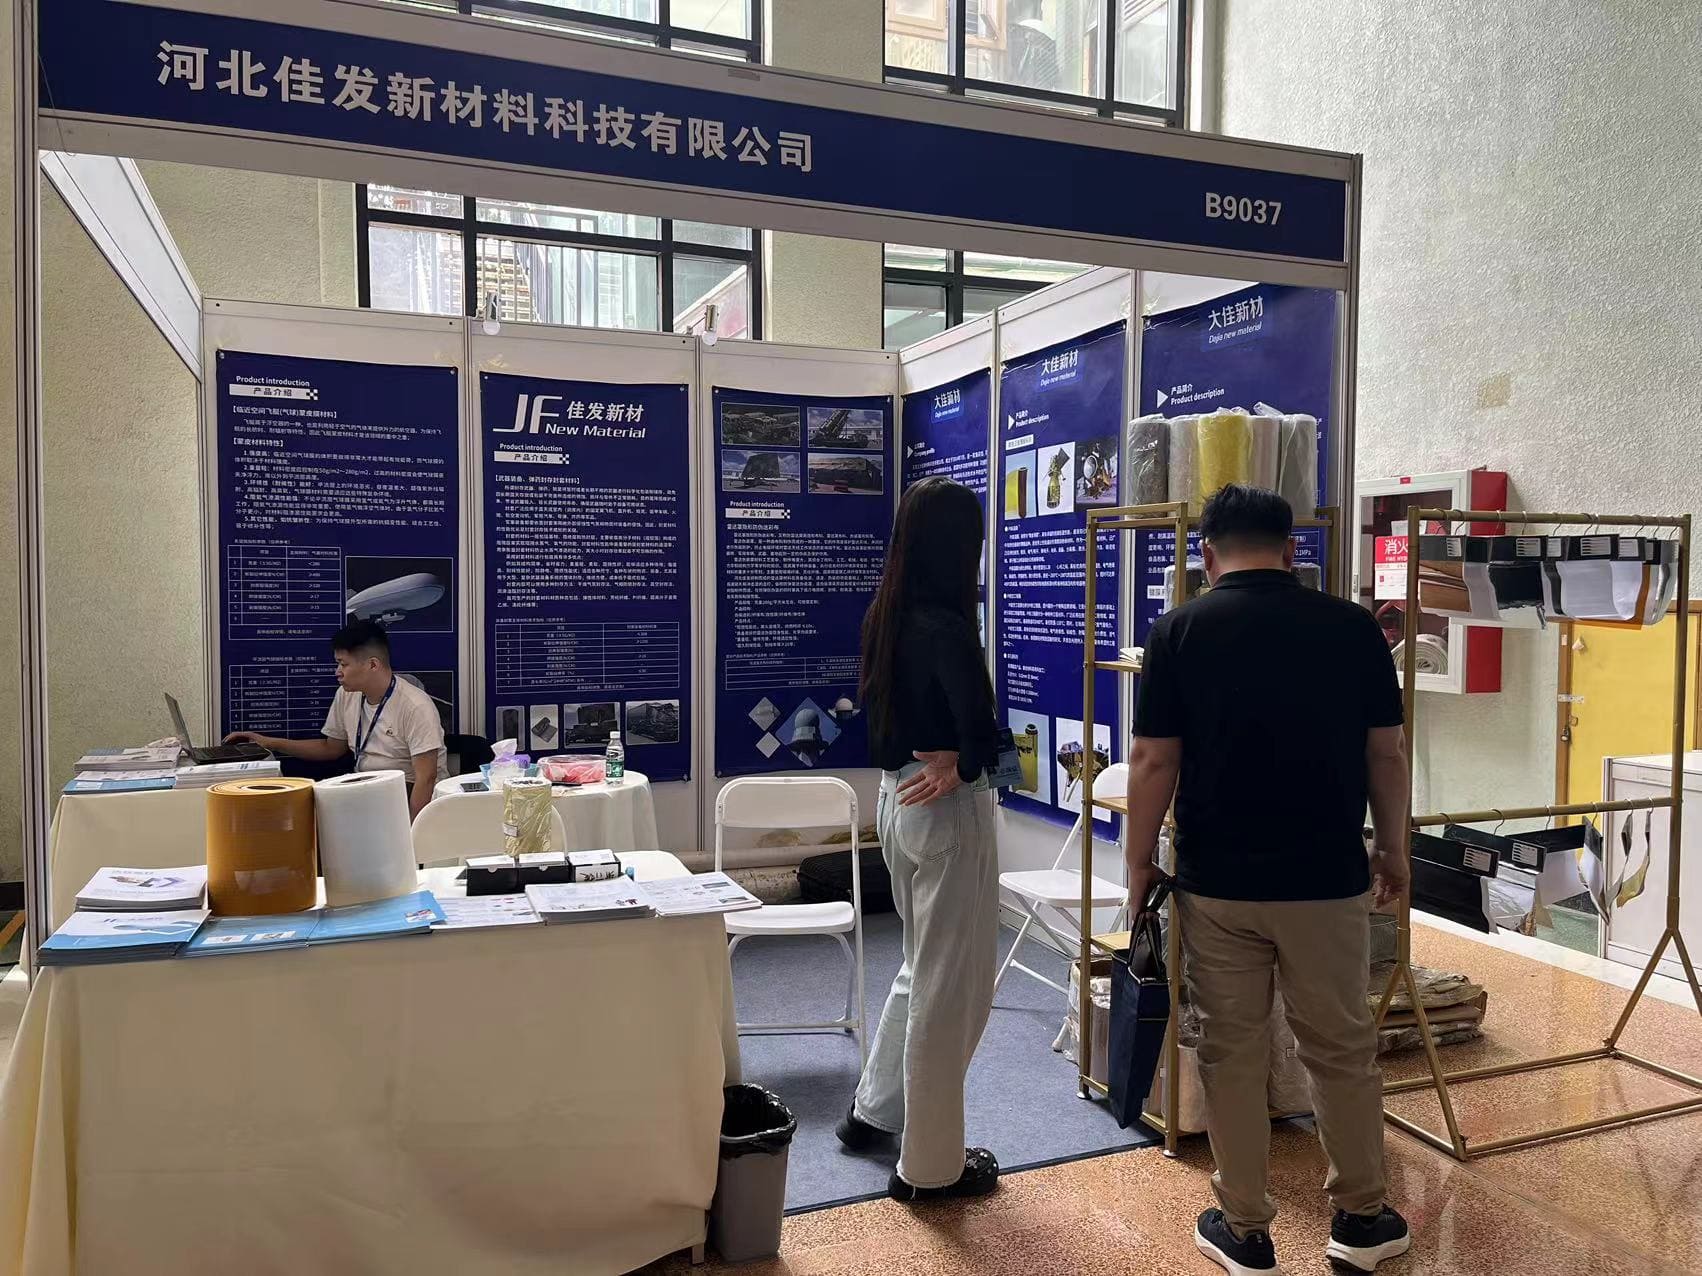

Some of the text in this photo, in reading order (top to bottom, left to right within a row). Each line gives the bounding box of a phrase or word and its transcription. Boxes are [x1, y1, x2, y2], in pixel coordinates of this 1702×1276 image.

[156, 40, 812, 172] 河北佳发新材料科技有限公司
[1205, 192, 1282, 225] B9037
[1208, 295, 1264, 331] 大佳新材
[1040, 348, 1079, 377] 大佳新材
[236, 375, 310, 387] Product introduction
[1170, 383, 1193, 395] 产品简介
[253, 387, 292, 397] 产品介绍
[934, 388, 960, 410] 大佳新材
[1170, 388, 1225, 406] Product description
[493, 394, 563, 434] JF
[567, 400, 644, 423] 佳发新材
[545, 423, 646, 439] New Material
[500, 443, 524, 451] Product
[514, 453, 548, 462] 产品介绍
